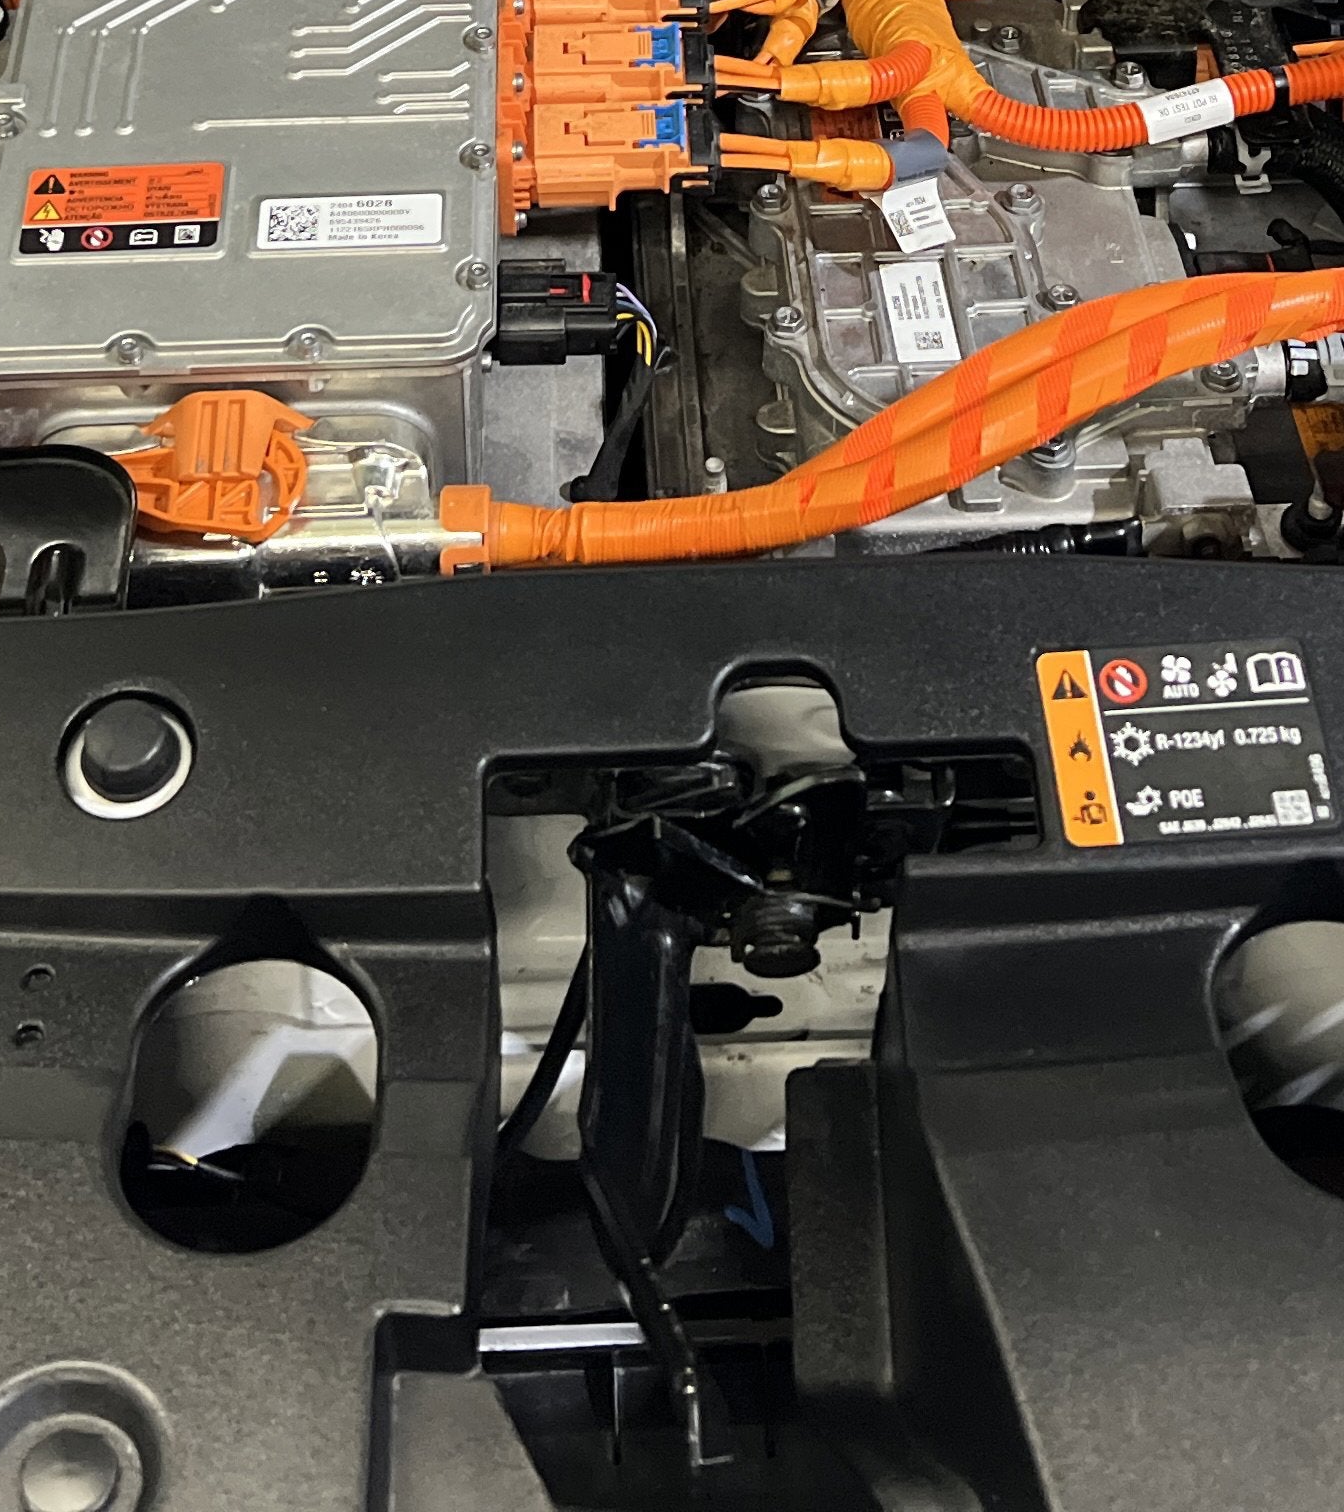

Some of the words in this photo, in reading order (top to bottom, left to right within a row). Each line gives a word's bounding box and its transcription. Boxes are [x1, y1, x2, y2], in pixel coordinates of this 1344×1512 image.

[1173, 103, 1191, 114] TEST
[1193, 98, 1208, 108] POT
[356, 199, 393, 208] 6028
[1162, 682, 1200, 700] AUTO
[1233, 726, 1278, 746] 0.725
[1278, 725, 1303, 746] kg
[1167, 788, 1205, 809] POE
